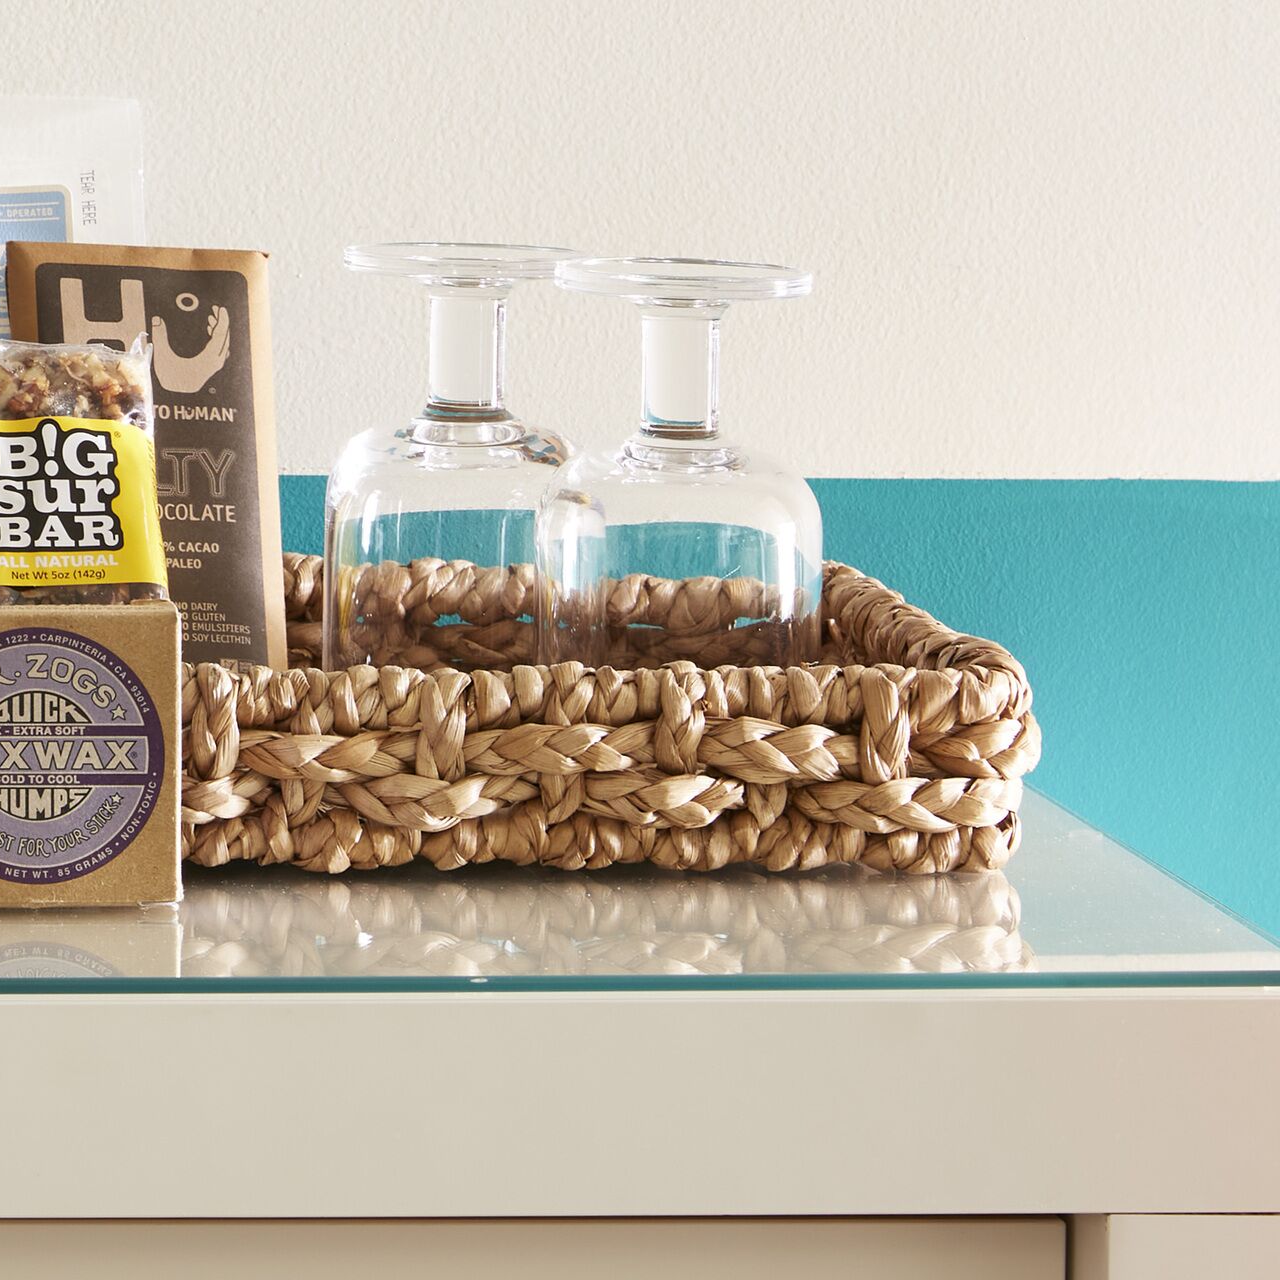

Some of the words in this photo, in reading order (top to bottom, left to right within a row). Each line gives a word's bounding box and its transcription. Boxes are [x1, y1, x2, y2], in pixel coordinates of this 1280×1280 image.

[178, 541, 220, 554] CACAO
[36, 554, 119, 568] NATURAL
[166, 558, 202, 570] PALEO
[11, 570, 30, 580] Net
[32, 570, 48, 580] Wt
[52, 570, 70, 580] 5oz
[73, 569, 106, 580] (142g)
[190, 602, 218, 612] DAIRY
[192, 612, 226, 622] GLUTEN
[192, 622, 251, 635] EMULSIFIERS
[192, 632, 210, 642] SOY
[211, 633, 252, 645] LECITHIN
[6, 633, 29, 644] 1222
[40, 633, 108, 664] CARPINTERIA
[114, 664, 127, 680] CA
[130, 684, 151, 714] 93014
[26, 653, 117, 708] ZOGS
[14, 726, 52, 736] EXTRA
[54, 726, 86, 736] SOFT
[27, 774, 44, 784] TO
[46, 774, 80, 784] COOL
[4, 867, 28, 879] NET
[32, 870, 54, 879] WT.
[58, 867, 71, 878] 85
[75, 846, 114, 872] GRAMS
[120, 780, 158, 842] NON-TOXIC
[18, 837, 51, 858] FOR
[48, 829, 88, 854] YOUR
[88, 800, 121, 836] STICK
